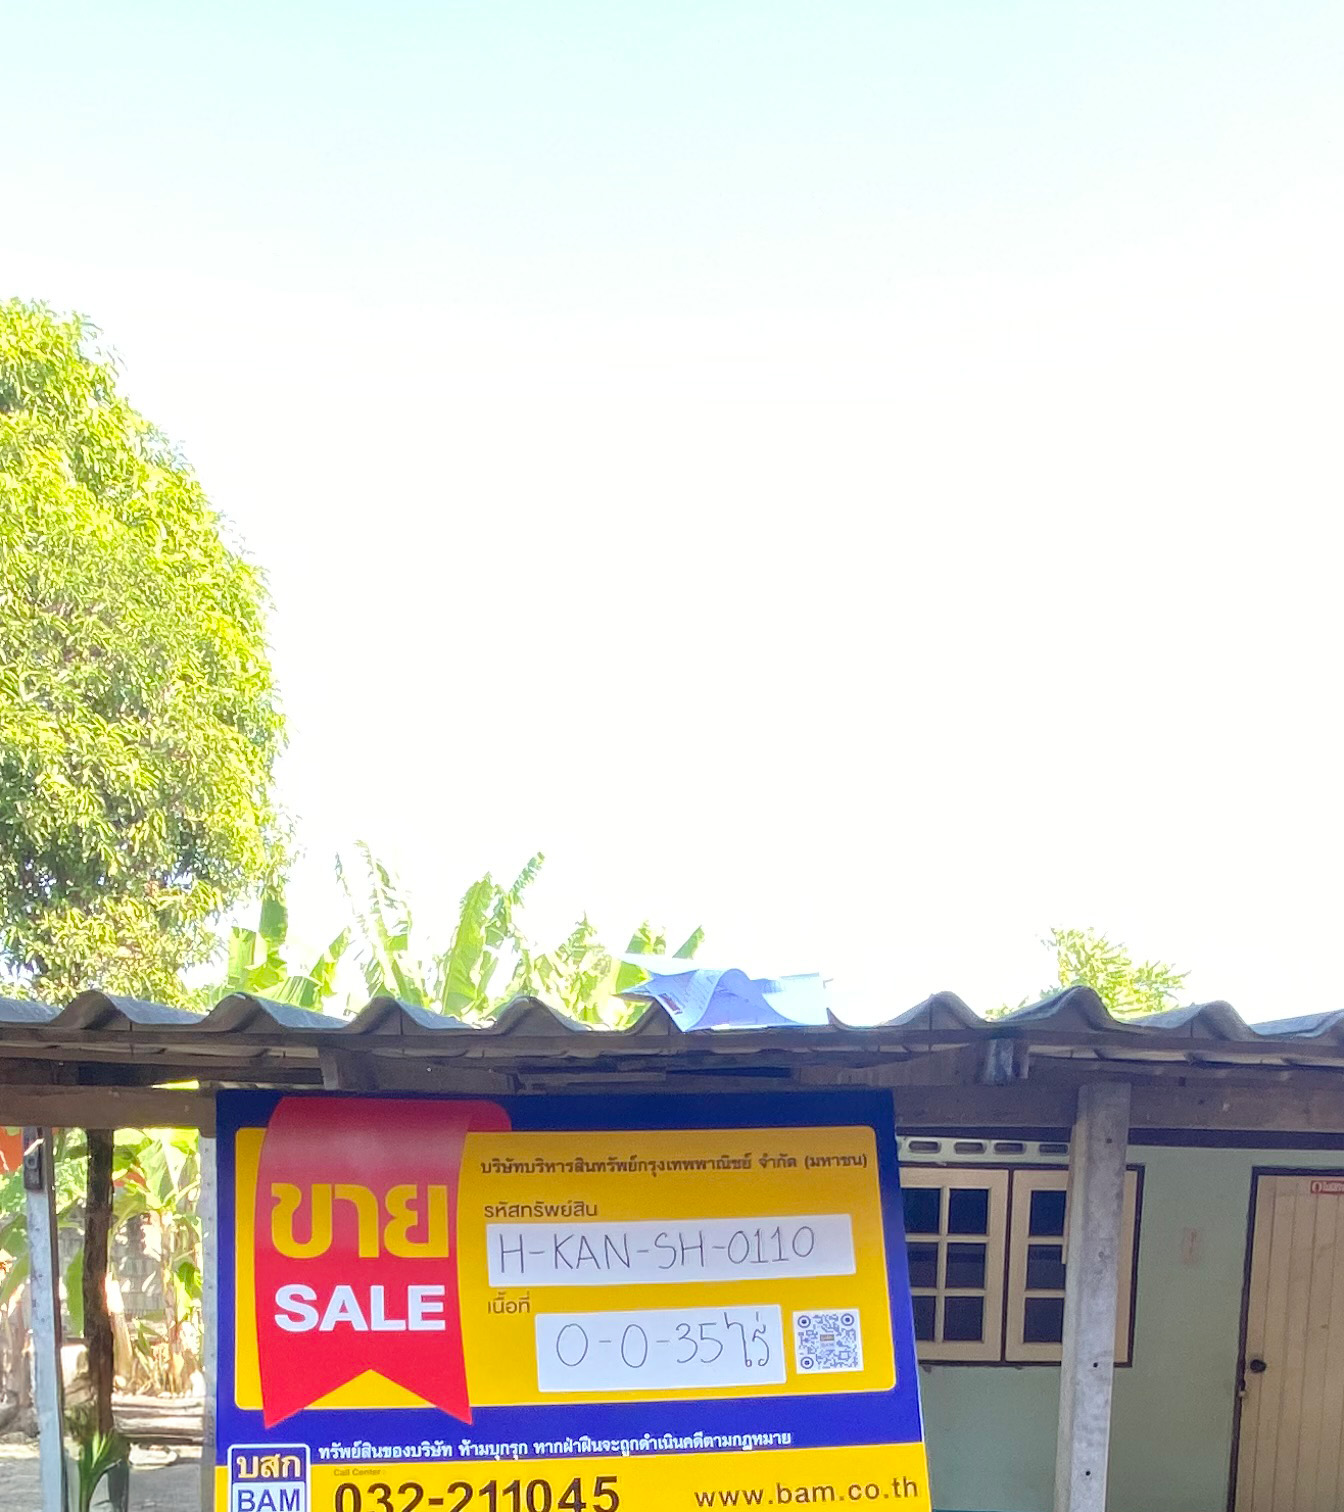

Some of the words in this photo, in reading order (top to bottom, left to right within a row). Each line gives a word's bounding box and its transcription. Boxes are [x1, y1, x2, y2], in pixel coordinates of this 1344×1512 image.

[480, 1153, 752, 1177] บริษัทบริหารสินทรัพย์กรุงเทพพาณิชย์
[759, 1153, 797, 1170] จำกัด
[804, 1153, 868, 1171] (มหาชน)
[271, 1183, 450, 1259] ขาย
[484, 1199, 598, 1219] รหัสทรัพย์สิน
[500, 1226, 815, 1273] H-KAN-SH-0110
[274, 1283, 447, 1333] SALE
[487, 1291, 531, 1316] เนื้อที่
[318, 1439, 453, 1460] ทรัพย์สินของบริษัท
[458, 1438, 529, 1461] ห้ามบุกรุก
[236, 1453, 302, 1480] บสก
[694, 1476, 919, 1508] www.bam.co.th
